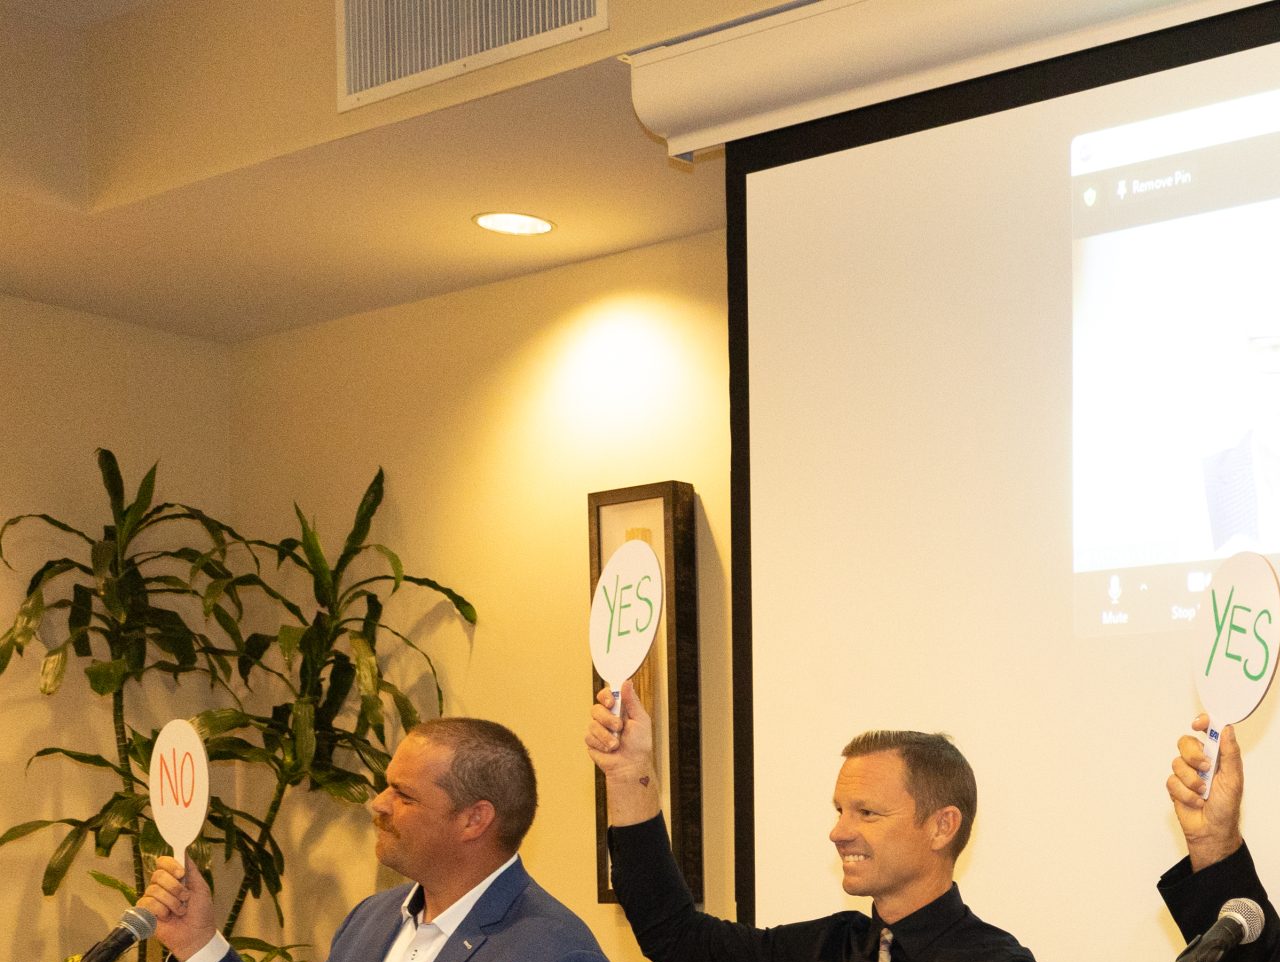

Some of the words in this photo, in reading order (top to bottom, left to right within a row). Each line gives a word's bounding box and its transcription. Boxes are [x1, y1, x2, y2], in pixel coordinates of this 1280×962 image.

[1132, 175, 1173, 194] Remove
[1174, 170, 1192, 186] Pin
[602, 574, 654, 654] YES
[1101, 611, 1129, 625] Mute
[1171, 604, 1196, 622] Stop
[1204, 585, 1272, 681] YES
[159, 747, 195, 808] NO
